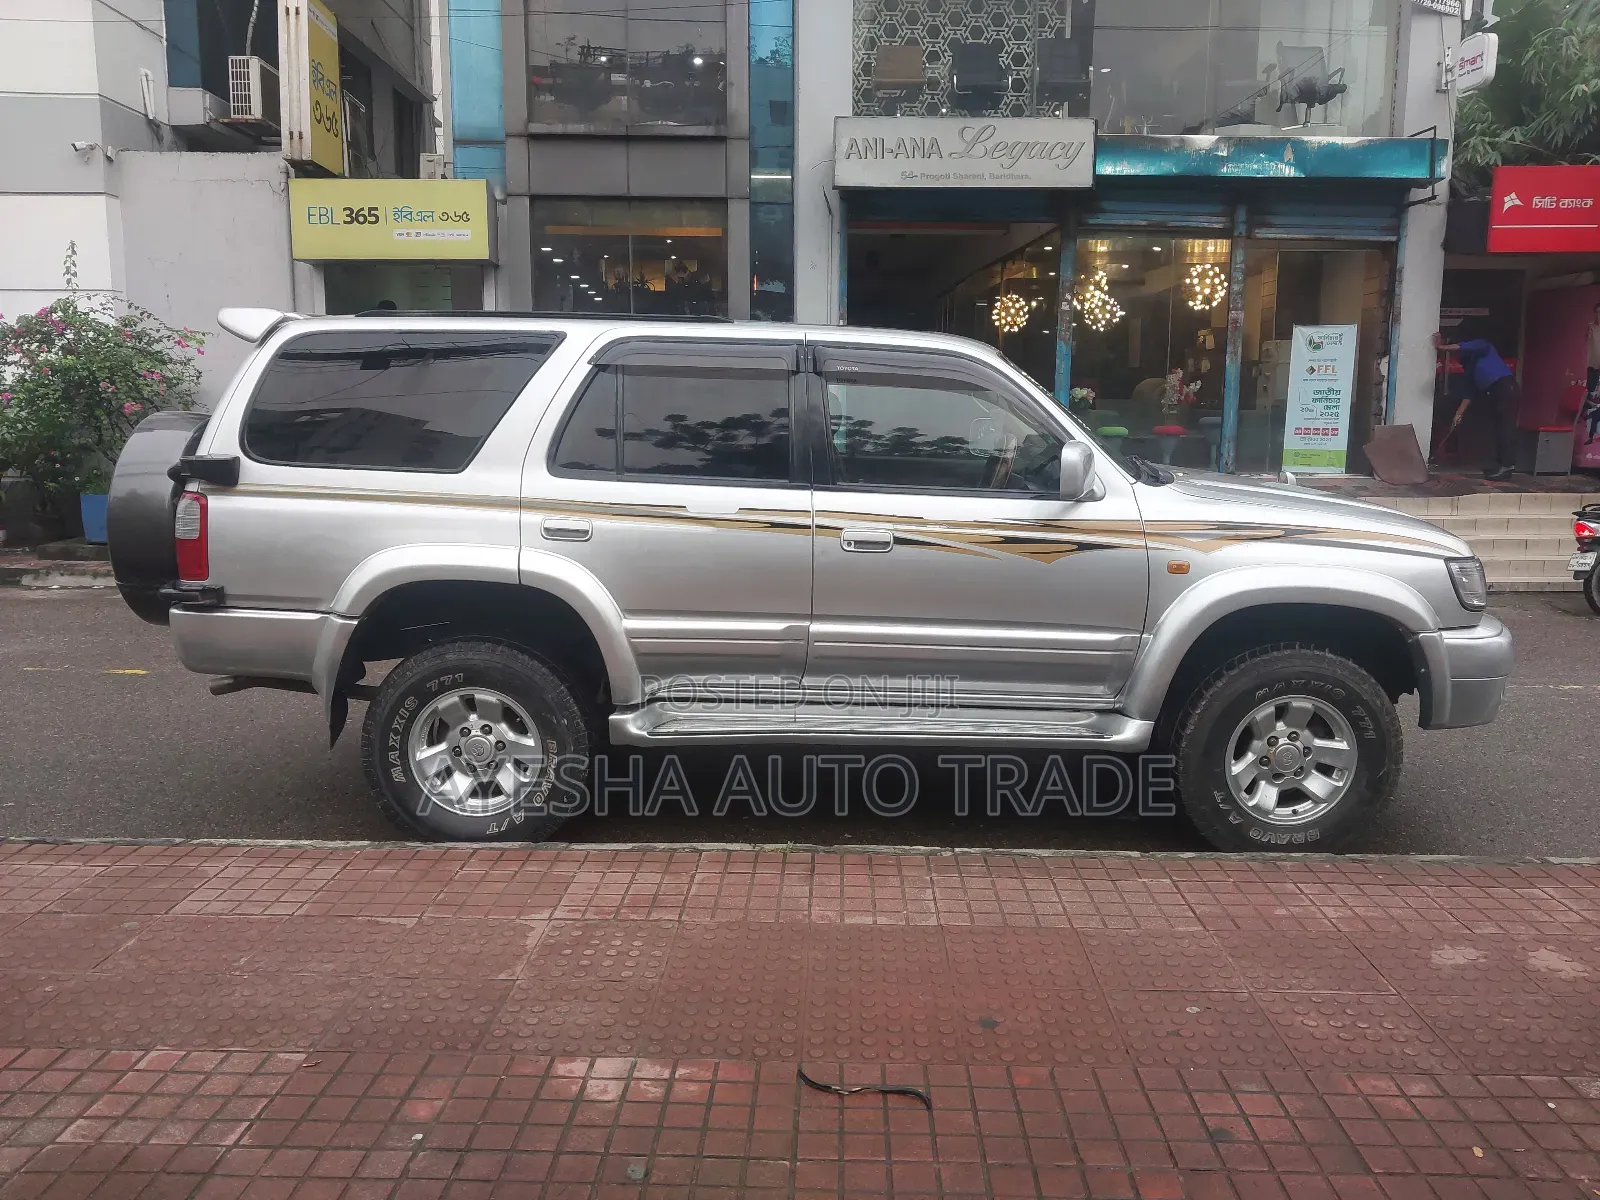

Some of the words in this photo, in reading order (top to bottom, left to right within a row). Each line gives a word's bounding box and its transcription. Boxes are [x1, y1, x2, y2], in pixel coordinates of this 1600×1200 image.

[312, 59, 337, 104] ইবিএল
[313, 100, 339, 138] ৩৬৫
[845, 136, 943, 160] ANI-ANA
[948, 124, 1086, 170] Legacy
[1532, 196, 1557, 208] সিটি
[1559, 198, 1594, 208] ব্যাংক
[307, 206, 340, 225] EBL
[342, 206, 380, 225] 365
[392, 205, 435, 223] ইবিএল
[438, 210, 471, 223] ৩৬৫
[1317, 365, 1337, 373] FFL
[1313, 387, 1341, 396] জাতীয়
[426, 673, 464, 692] 771
[388, 696, 418, 783] MAXXIS
[532, 740, 558, 807] BRAVO
[1249, 827, 1321, 845] BRAVO
